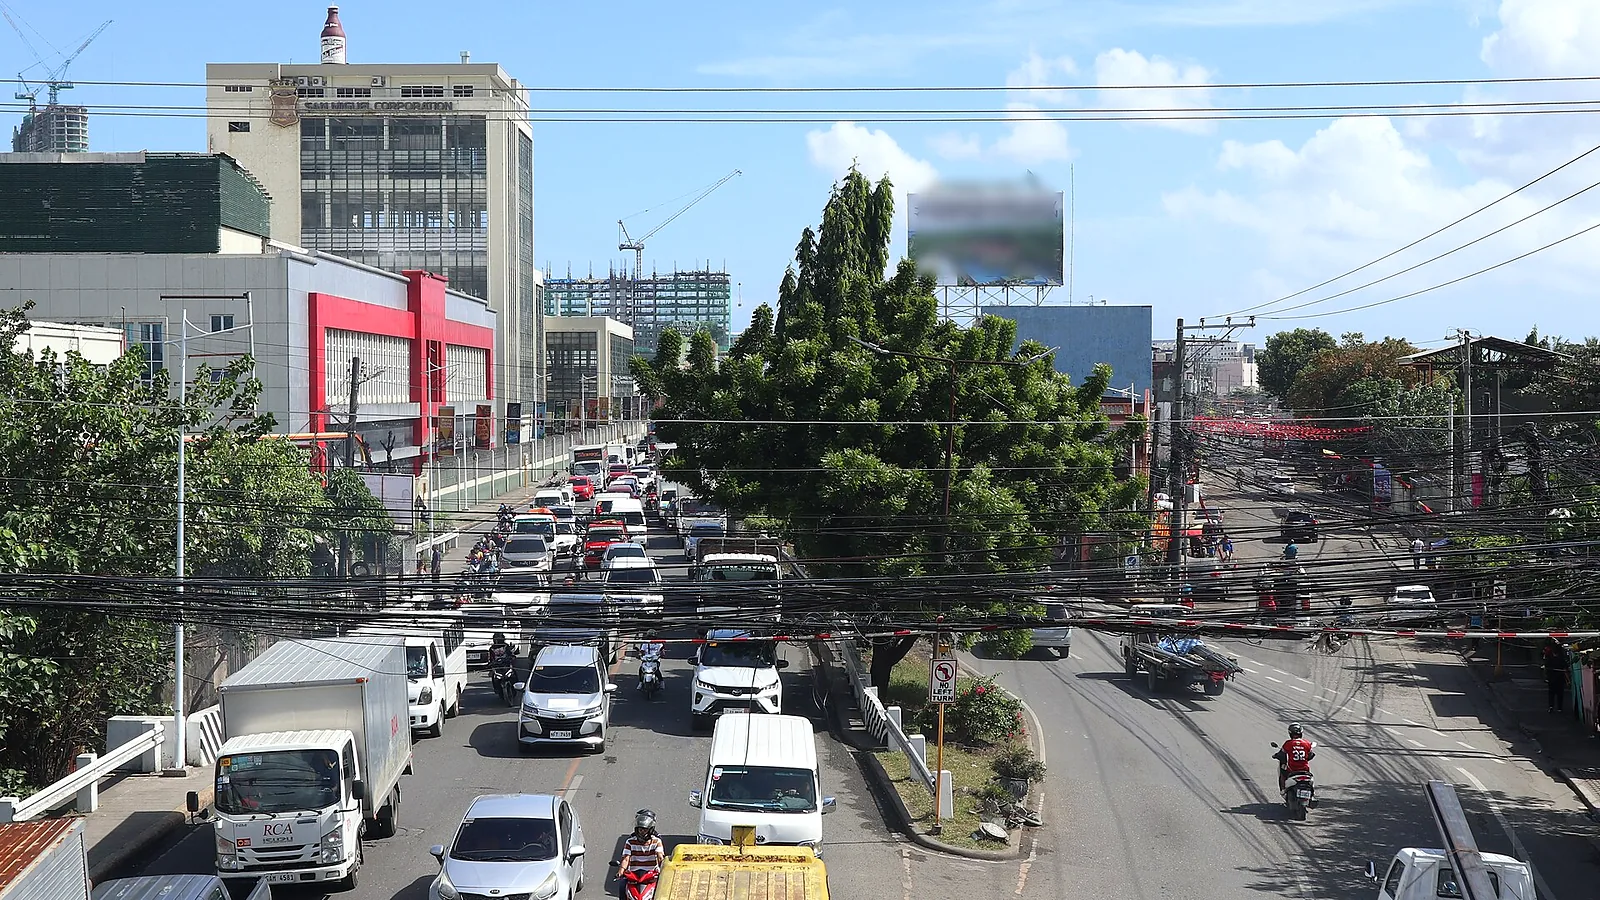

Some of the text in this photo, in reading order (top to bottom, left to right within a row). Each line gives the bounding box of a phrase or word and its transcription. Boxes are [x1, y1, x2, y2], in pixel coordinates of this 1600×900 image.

[304, 102, 453, 110] SAN MIGUEL CORPORATION
[1292, 750, 1307, 760] 32
[263, 823, 293, 836] RCA
